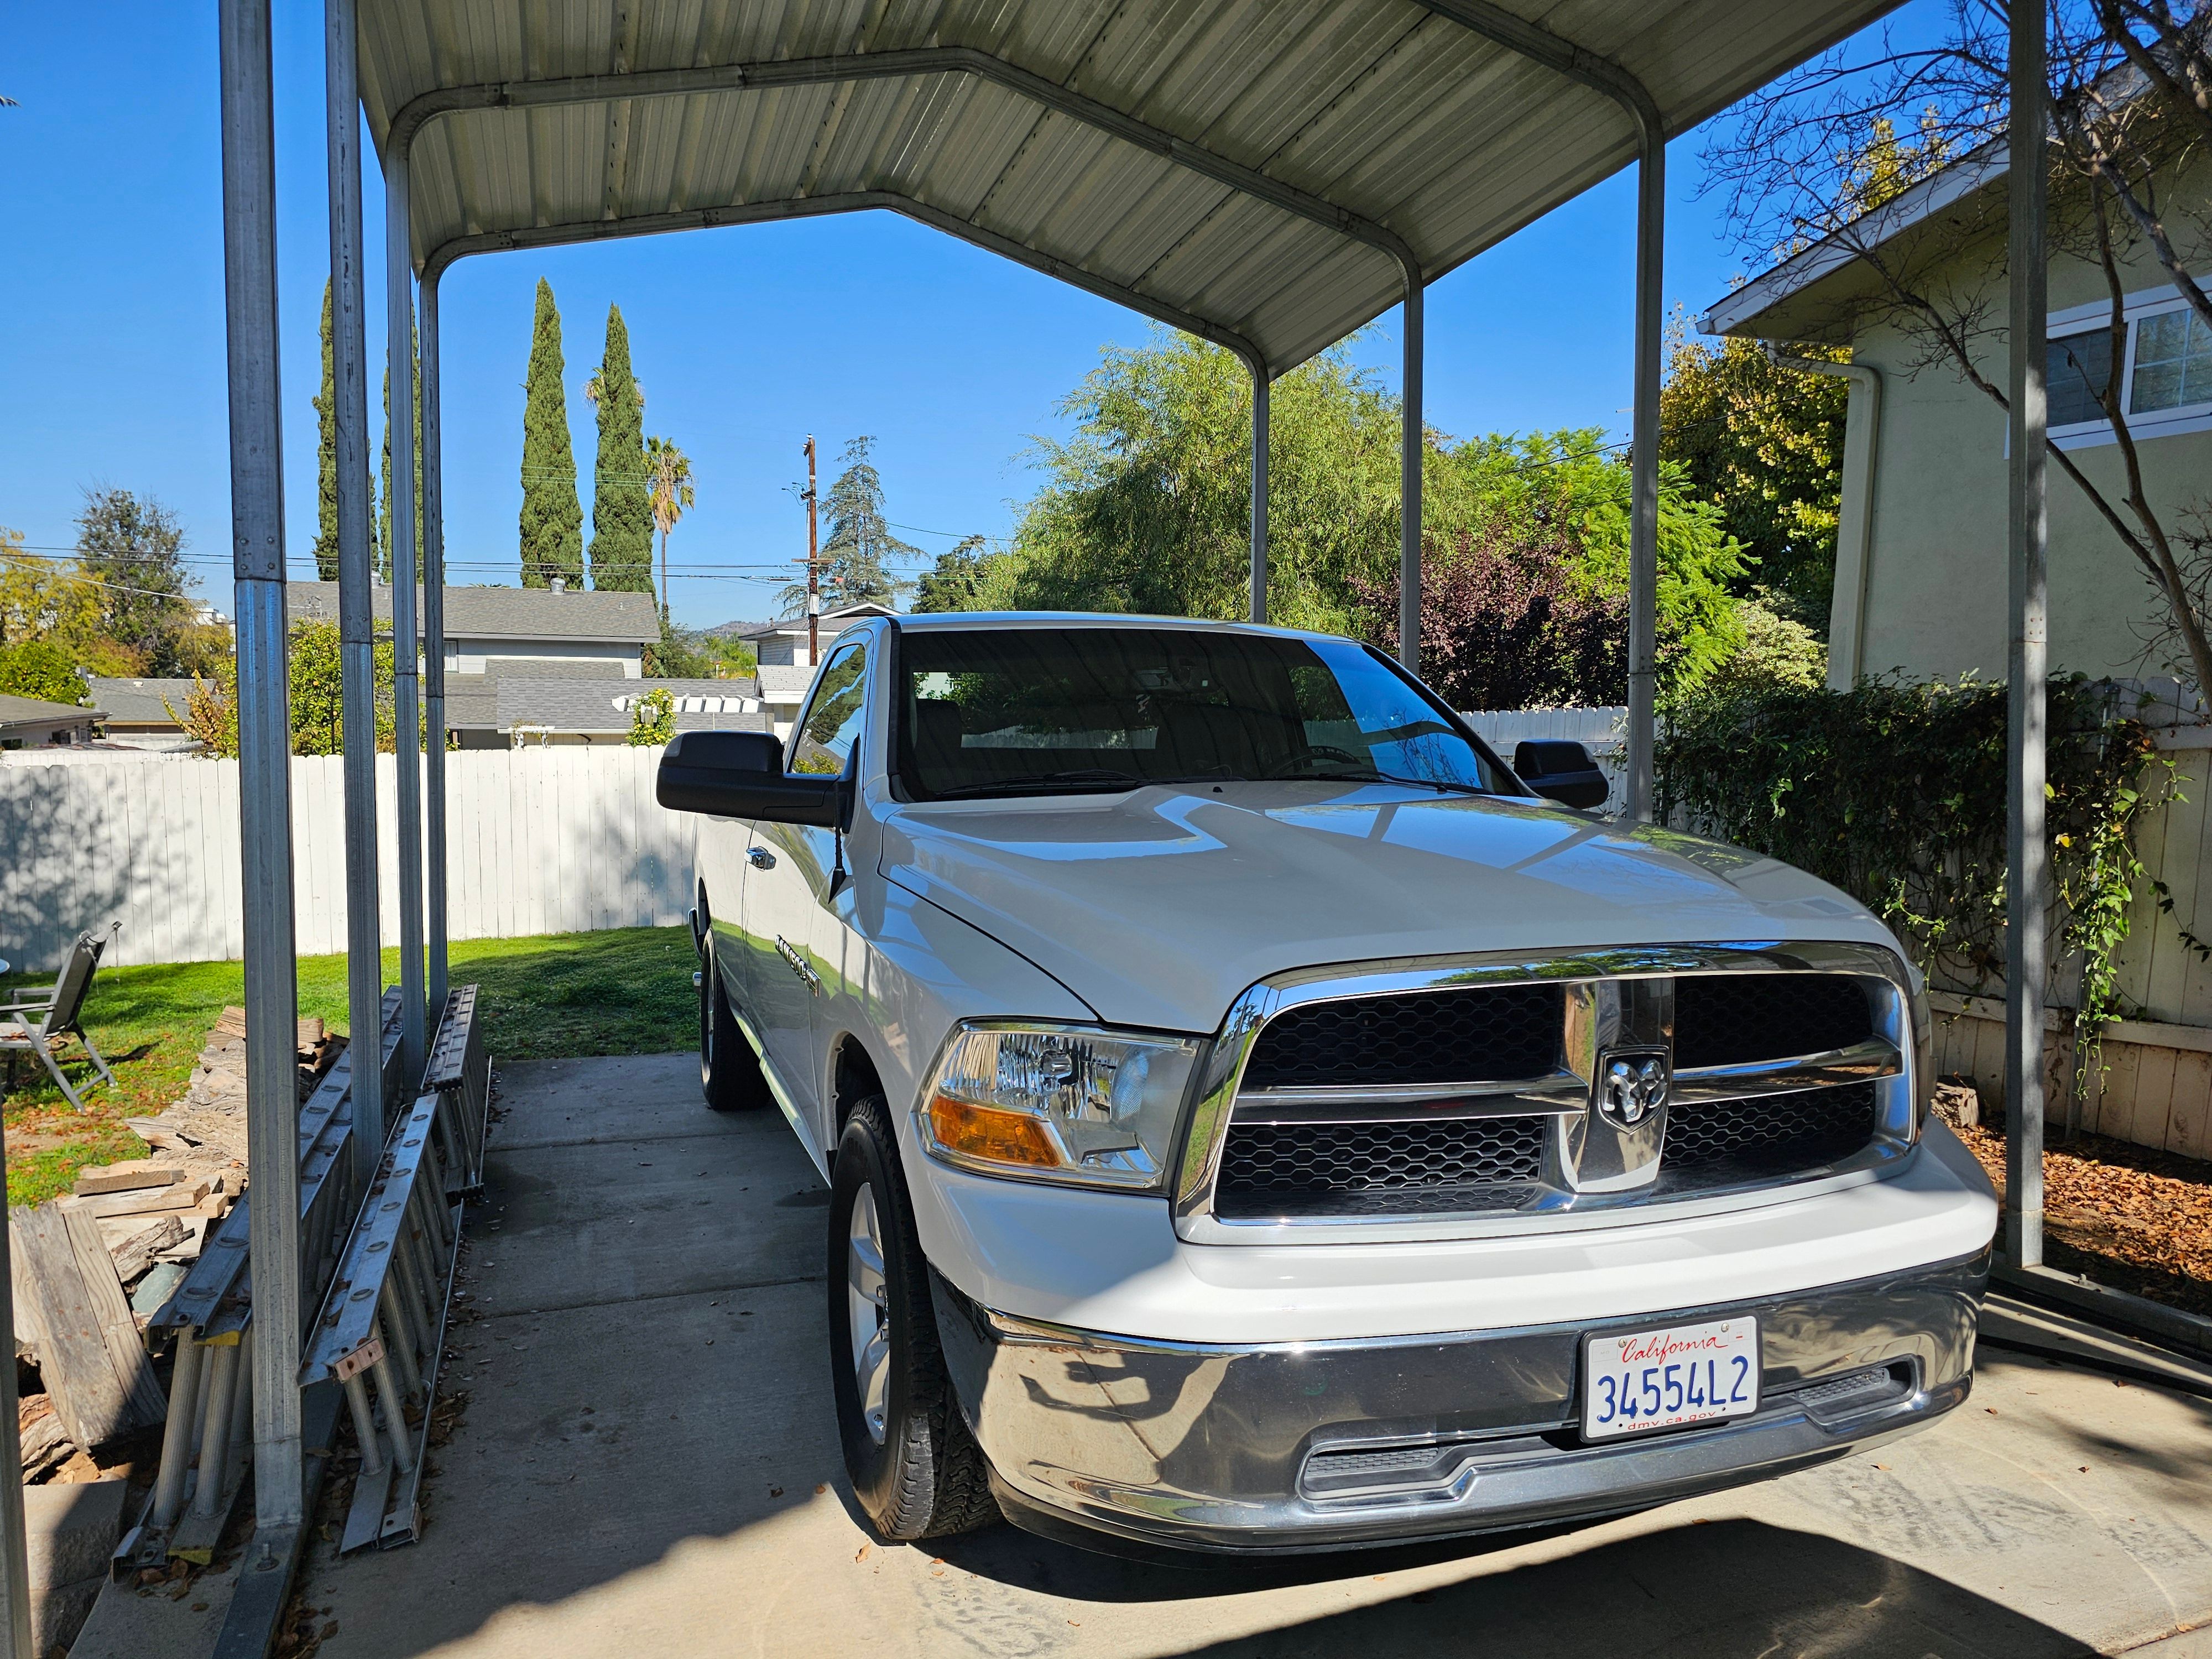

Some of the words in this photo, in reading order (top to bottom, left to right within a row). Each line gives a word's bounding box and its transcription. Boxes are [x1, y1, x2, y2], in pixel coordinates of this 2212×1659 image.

[1622, 1331, 1728, 1365] California
[1597, 1355, 1749, 1423] 34554L2
[1628, 1411, 1716, 1431] dmv.ca.gov
